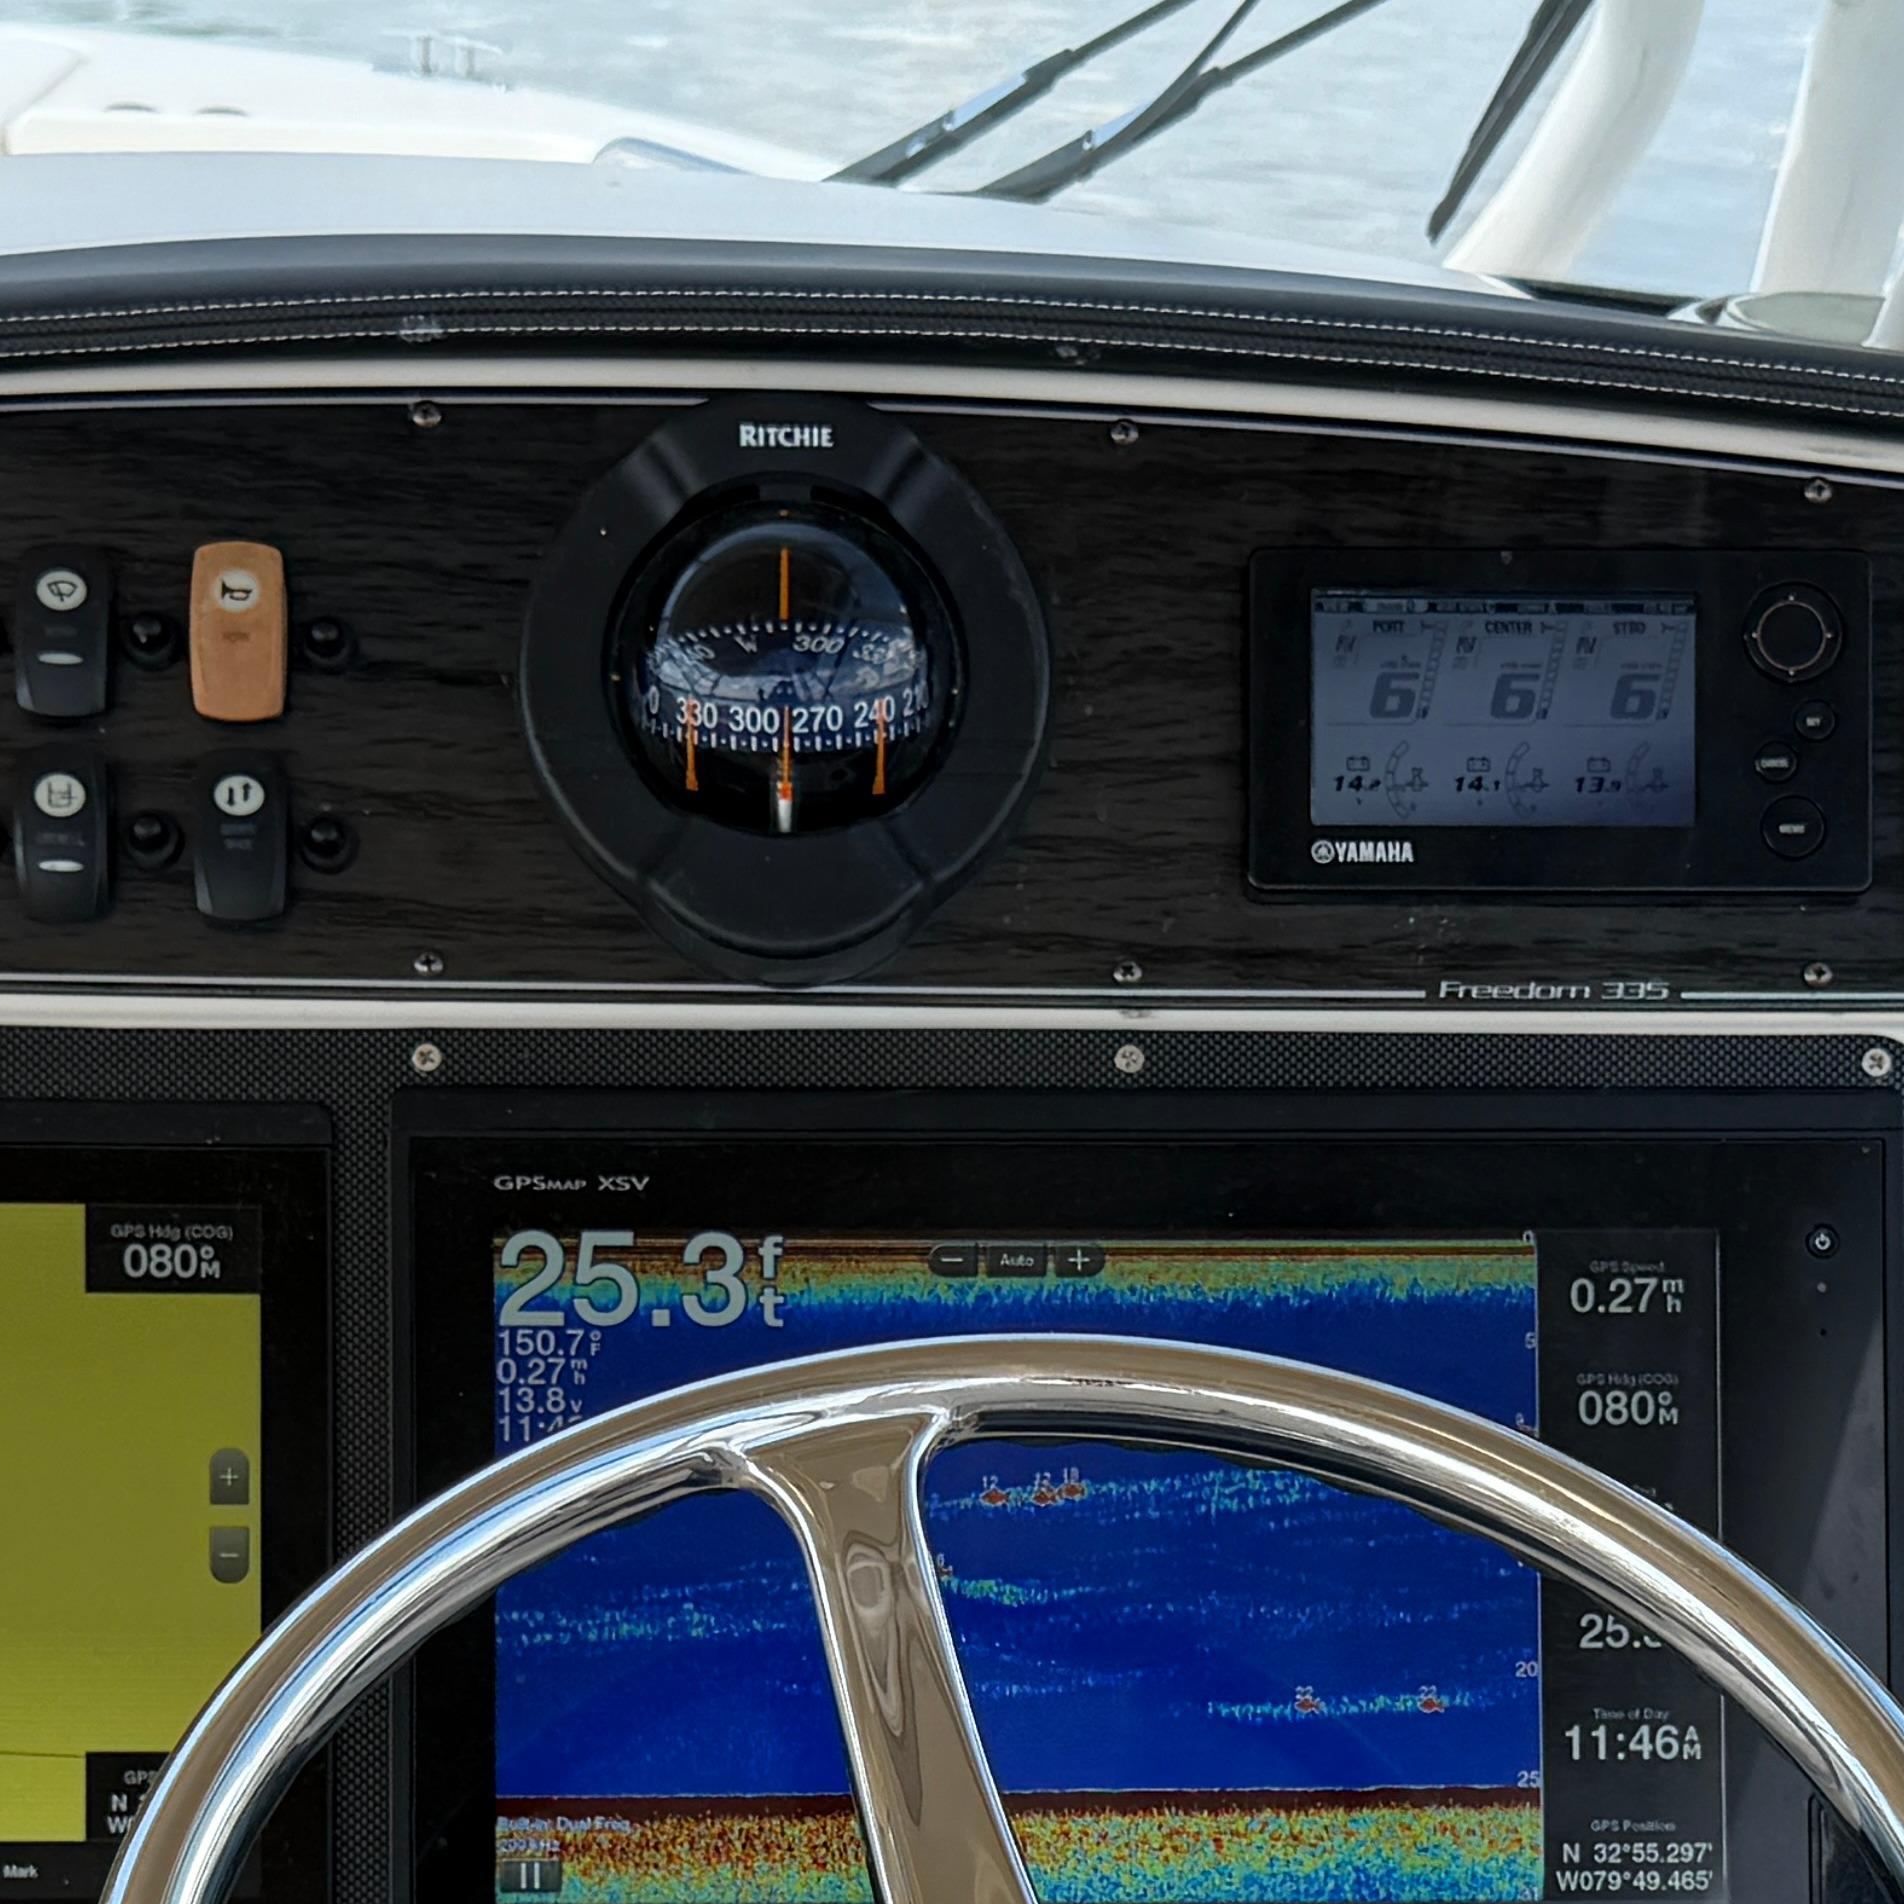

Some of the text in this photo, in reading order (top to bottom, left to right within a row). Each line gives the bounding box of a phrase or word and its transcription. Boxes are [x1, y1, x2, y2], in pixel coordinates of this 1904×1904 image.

[739, 422, 833, 448] RITCHIE
[1485, 621, 1533, 635] CENTER
[1369, 671, 1421, 720] 6
[1490, 672, 1542, 720] 6
[1609, 672, 1662, 720] 6
[729, 706, 779, 733] 300
[792, 705, 843, 733] 270
[854, 695, 895, 728] 240
[1335, 841, 1414, 863] YAMAHA
[1439, 979, 1670, 1000] Freedom 335
[597, 1176, 650, 1191] XSV
[111, 1223, 234, 1242] GPS Hdg (COG)
[123, 1244, 197, 1279] 080
[999, 1252, 1035, 1267] Auto
[498, 1230, 747, 1328] 25.3
[1570, 1277, 1658, 1314] 0.27
[498, 1329, 585, 1356] 150.7
[497, 1358, 565, 1385] 0.27
[499, 1387, 565, 1413] 13.8
[1578, 1390, 1655, 1426] 080
[1515, 1662, 1538, 1678] 20
[1565, 1725, 1680, 1760] 11:46
[1517, 1771, 1540, 1787] 25
[1562, 1844, 1581, 1863] N
[3, 1864, 38, 1880] Mark
